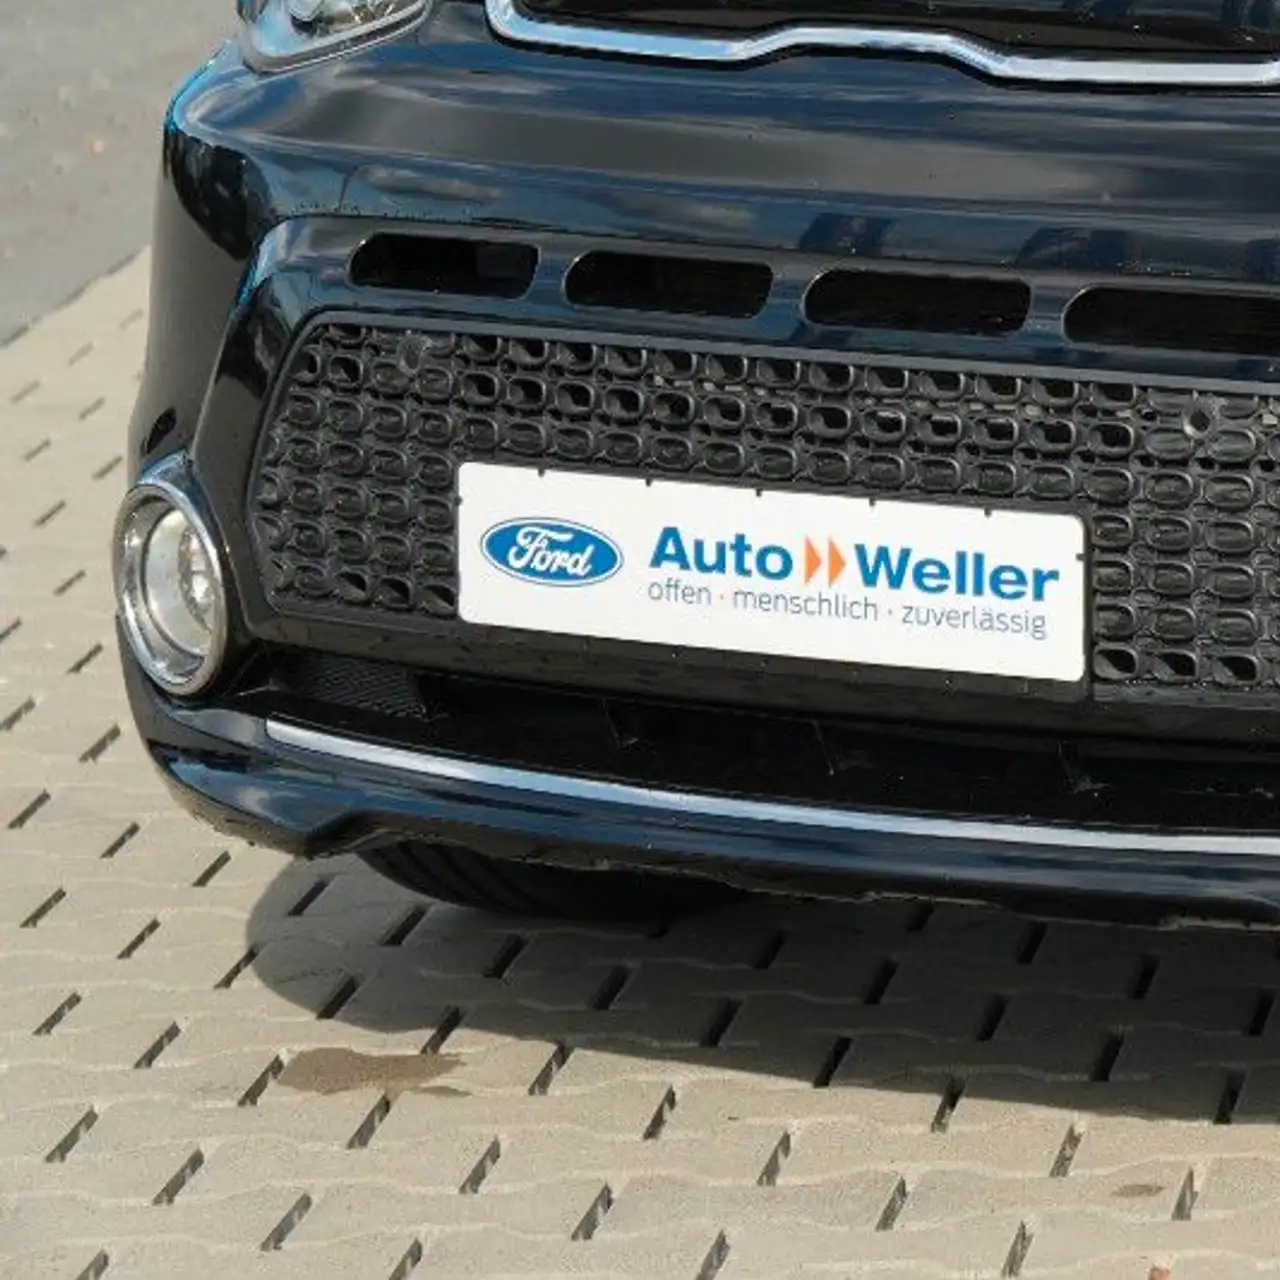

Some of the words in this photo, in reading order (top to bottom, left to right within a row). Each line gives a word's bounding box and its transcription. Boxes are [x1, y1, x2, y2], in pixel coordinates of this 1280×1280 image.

[507, 526, 597, 577] Ford
[649, 526, 793, 581] Auto
[854, 543, 1060, 602] Weller
[648, 577, 712, 606] offen
[732, 589, 878, 622] menschlich
[901, 604, 1048, 641] zuverlässig
